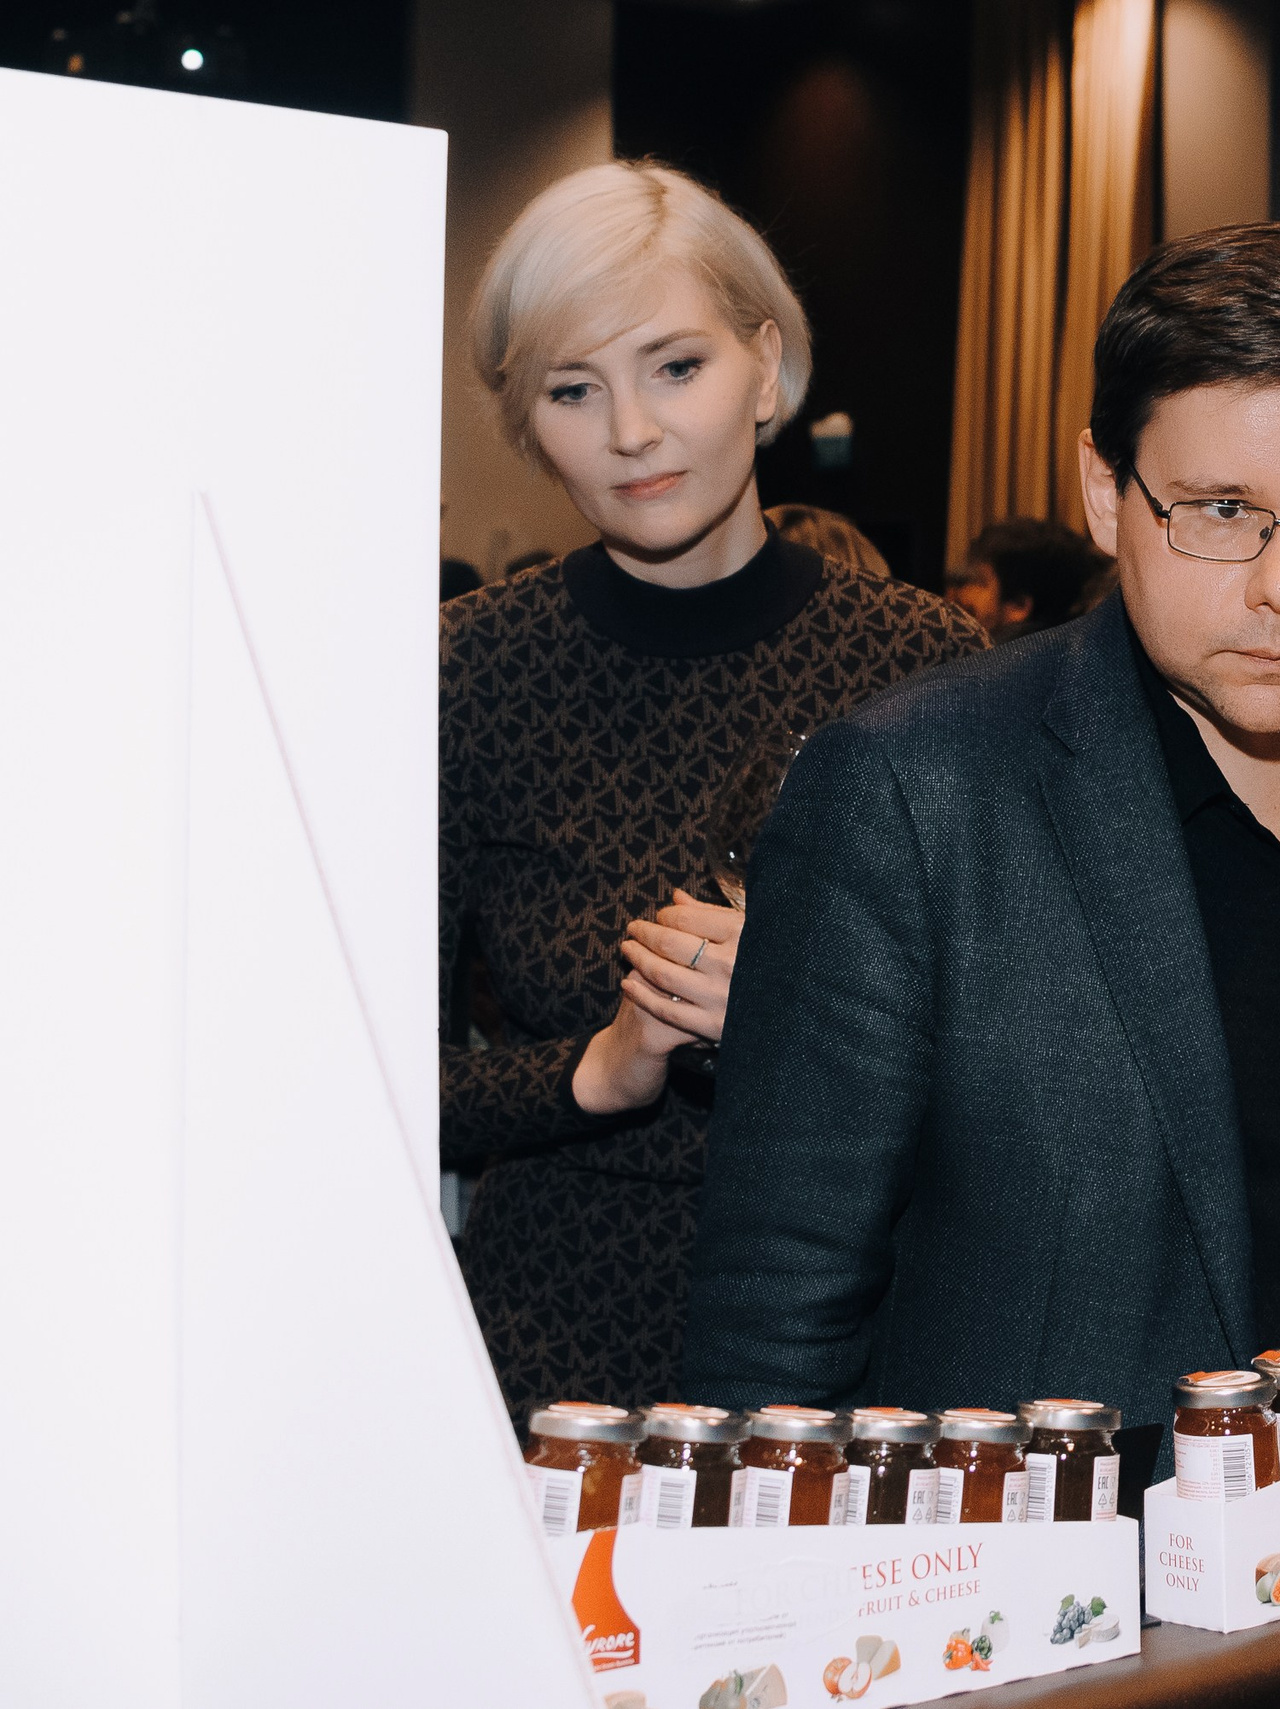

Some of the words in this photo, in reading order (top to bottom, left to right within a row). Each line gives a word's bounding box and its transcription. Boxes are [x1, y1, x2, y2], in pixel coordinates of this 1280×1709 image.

[1169, 1532, 1194, 1551] FOR
[911, 1542, 983, 1580] ONLY
[1159, 1551, 1205, 1573] CHEESE
[908, 1589, 920, 1607] &
[924, 1579, 981, 1604] CHEESE
[1165, 1572, 1199, 1592] ONLY
